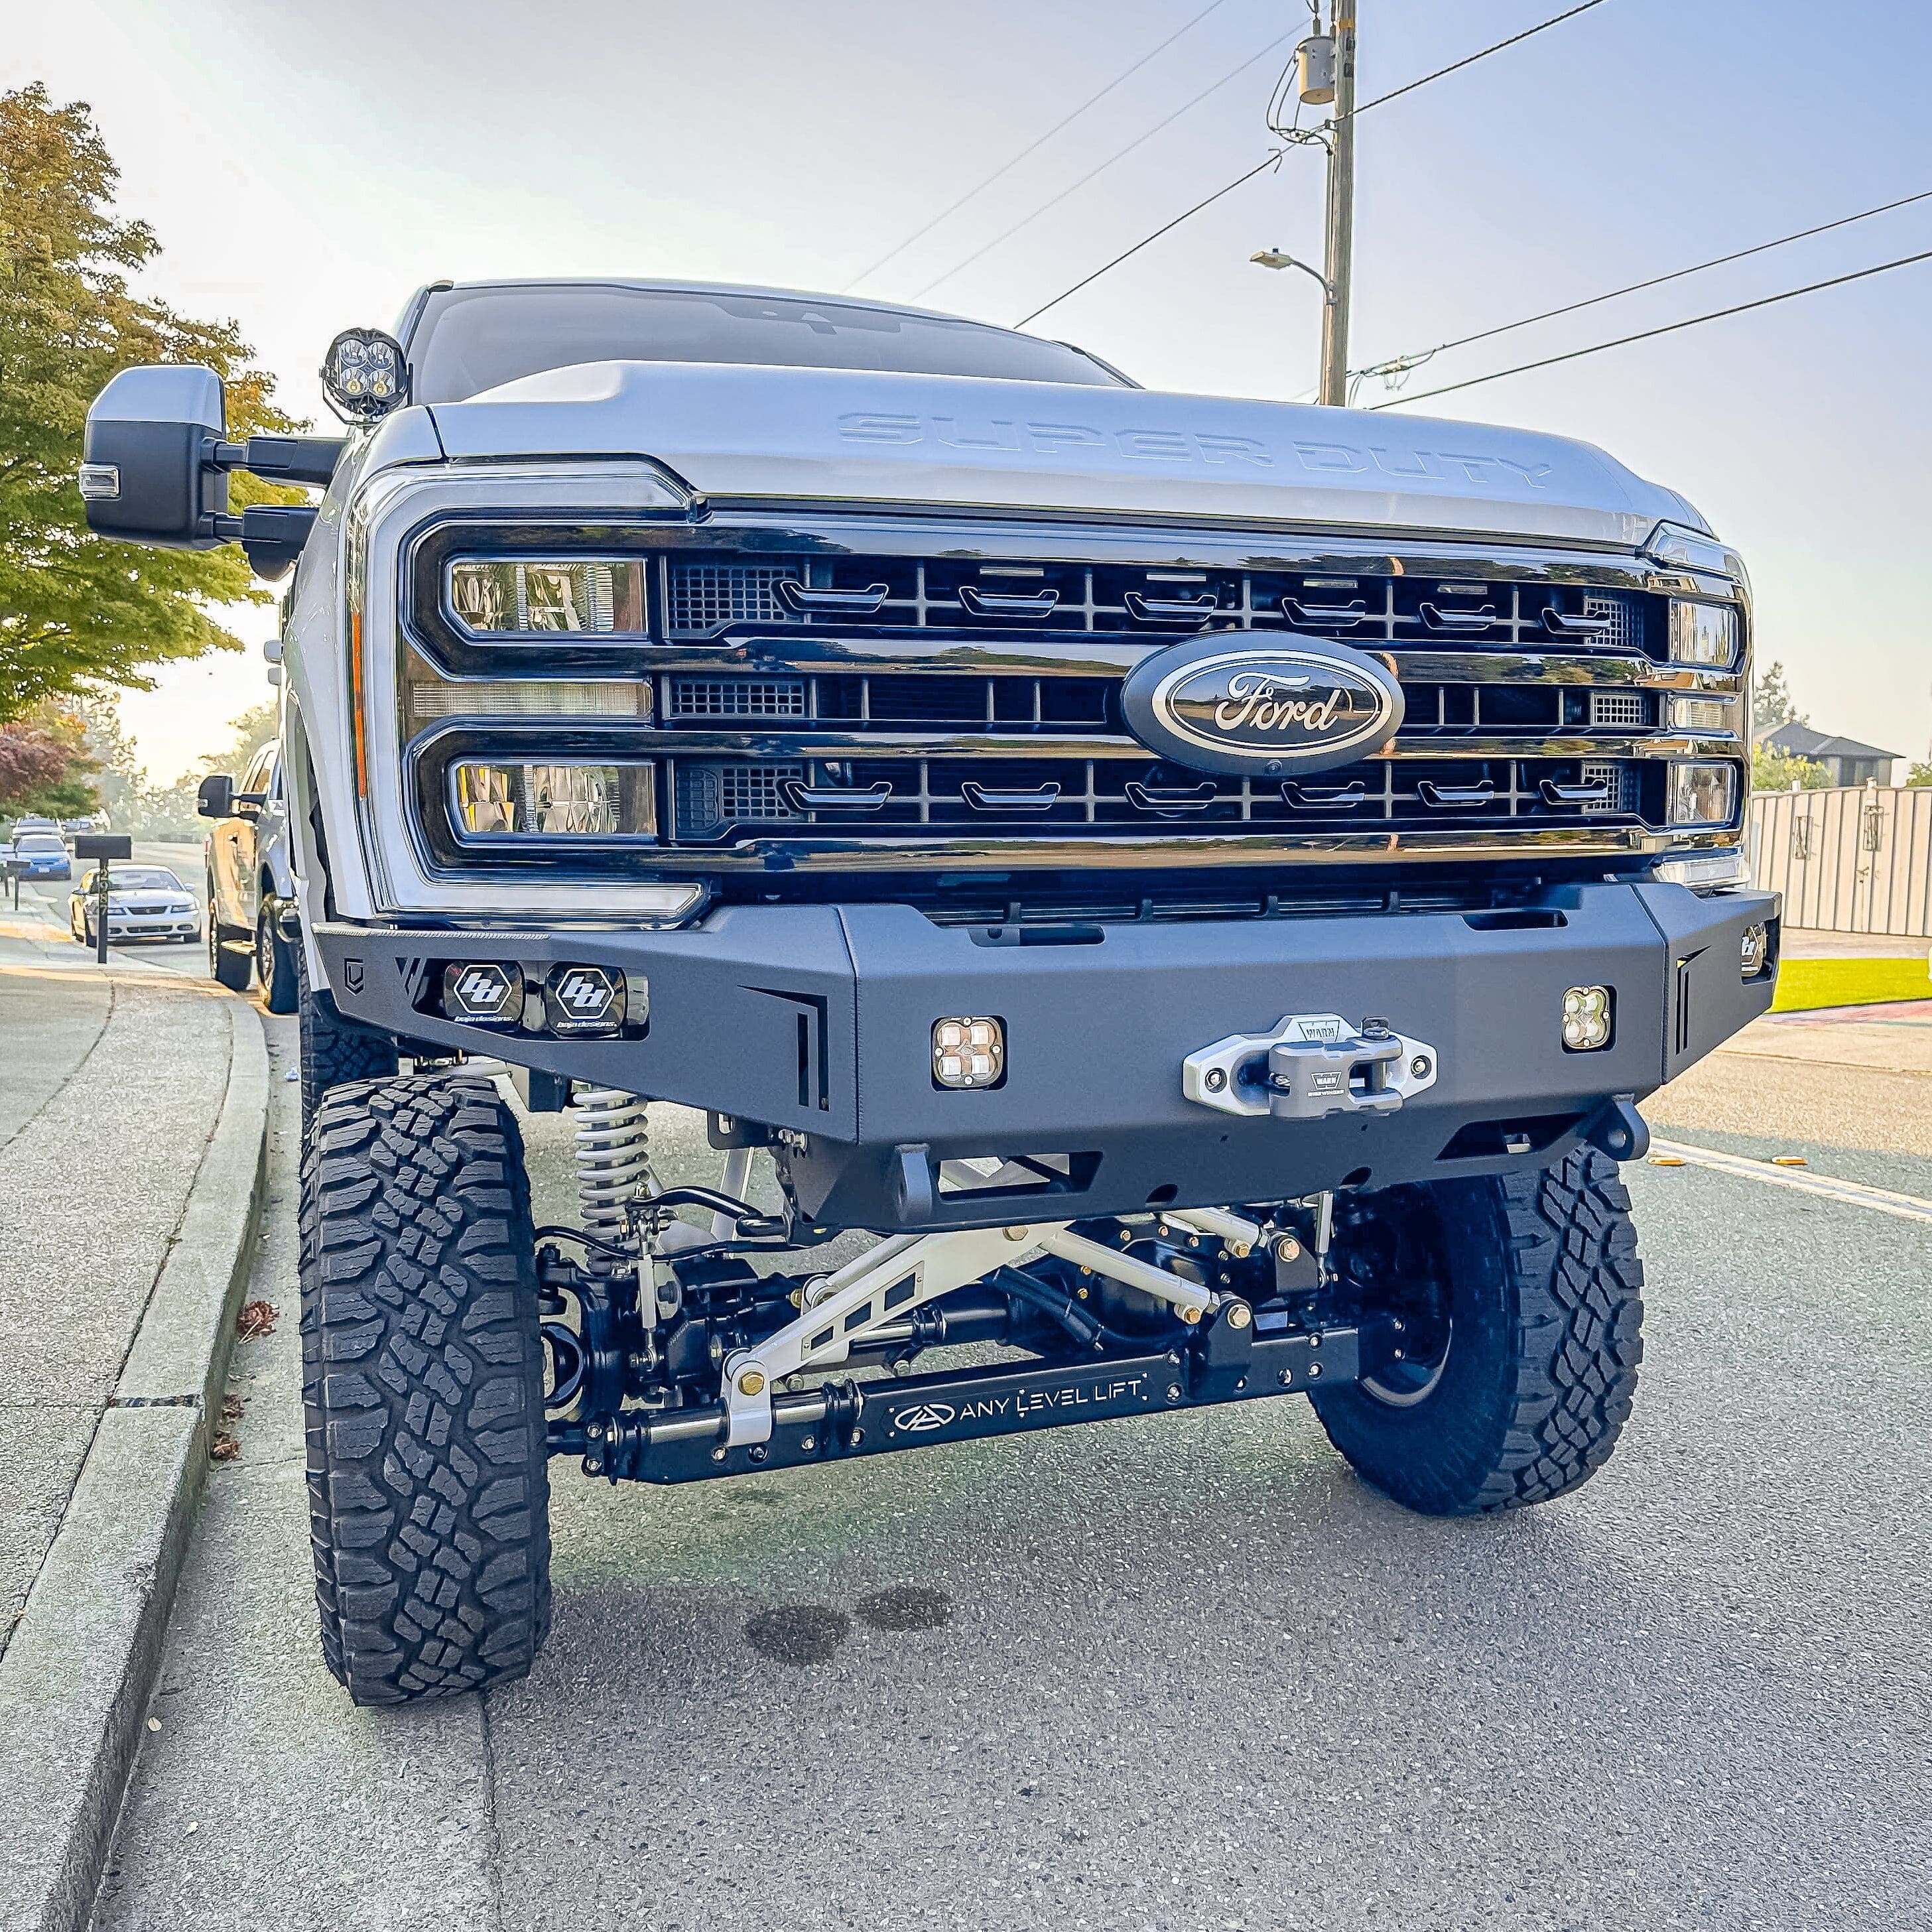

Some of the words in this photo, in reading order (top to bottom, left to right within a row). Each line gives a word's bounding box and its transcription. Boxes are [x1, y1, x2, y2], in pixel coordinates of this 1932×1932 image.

[837, 413, 1275, 468] SUPER
[1293, 440, 1553, 489] DUTY
[1214, 671, 1342, 732] Ford
[1306, 1027, 1335, 1039] WARN
[959, 1397, 1010, 1421] ANY
[1016, 1387, 1088, 1412] LEVEL
[1094, 1380, 1141, 1401] LIFT
